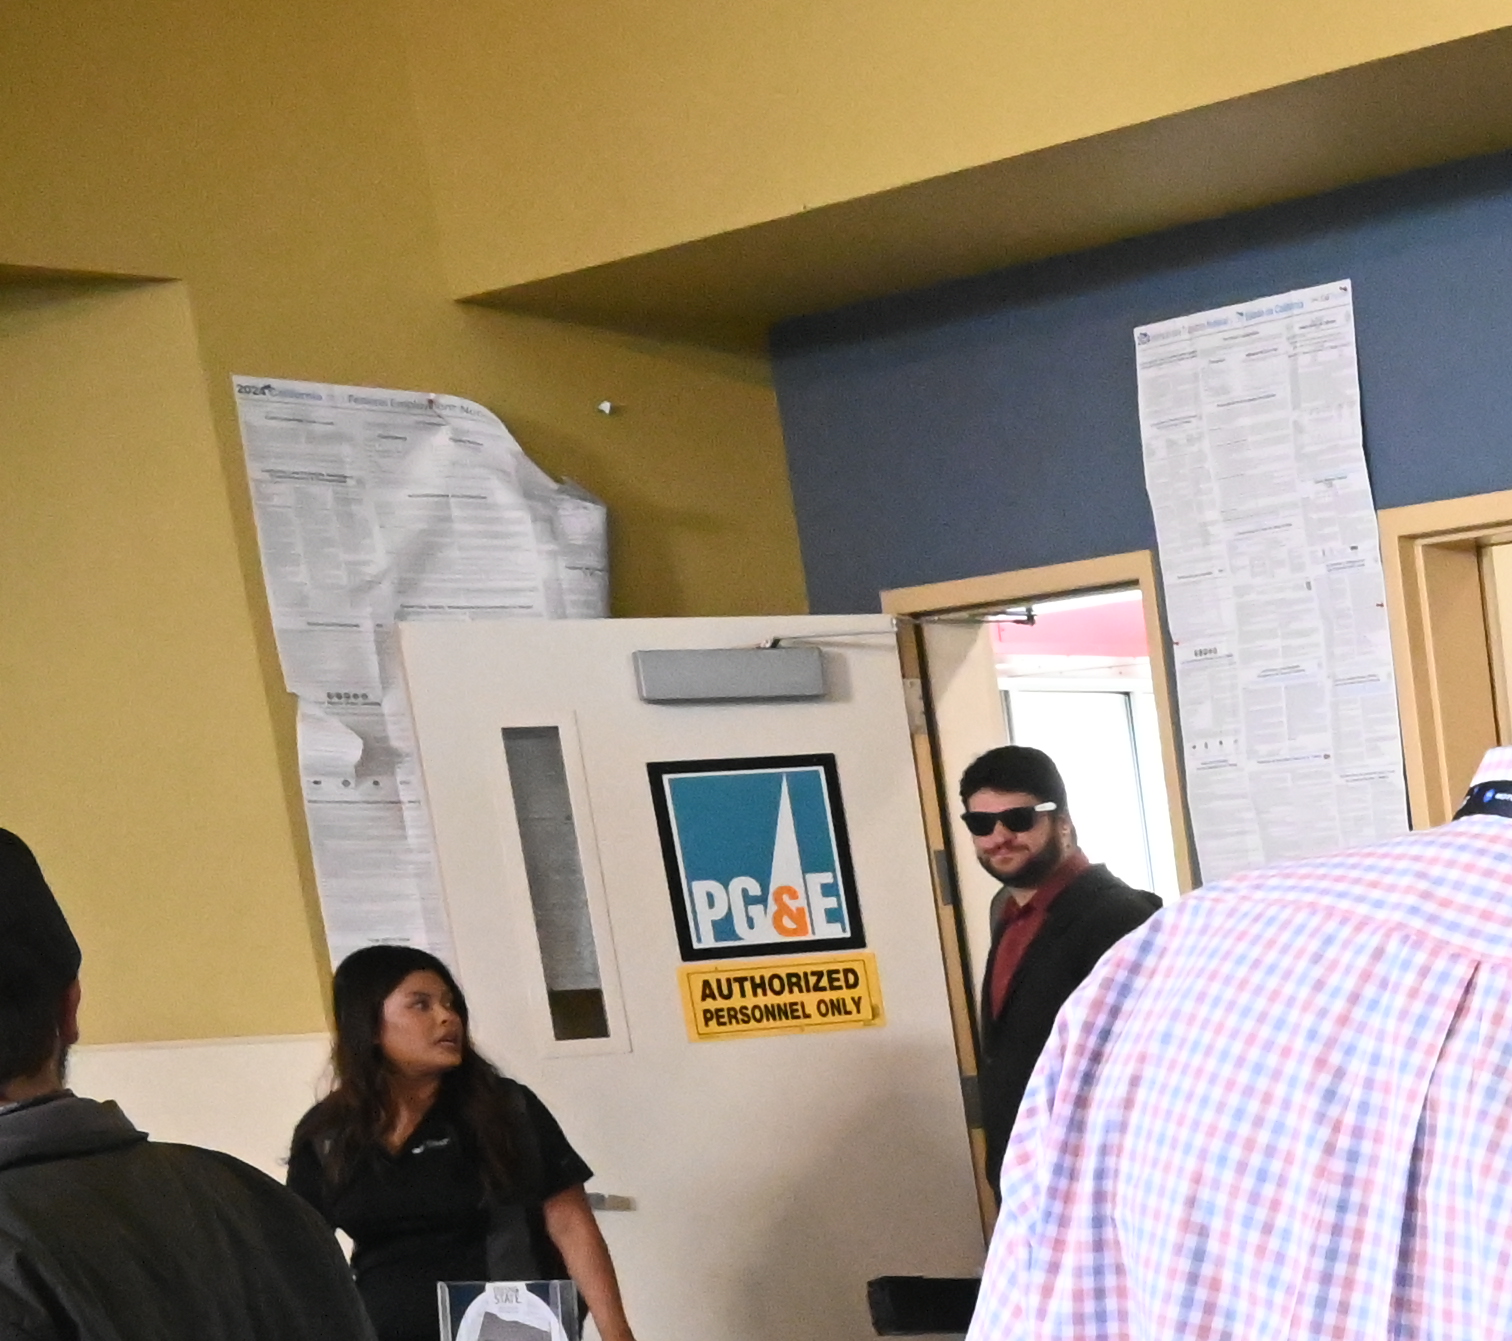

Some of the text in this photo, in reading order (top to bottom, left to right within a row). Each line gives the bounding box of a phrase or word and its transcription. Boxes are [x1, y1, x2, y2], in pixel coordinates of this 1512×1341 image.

[691, 871, 842, 945] PG&E
[700, 967, 860, 1002] AUTHORIZED
[702, 996, 862, 1027] PERSONNEL ONLY
